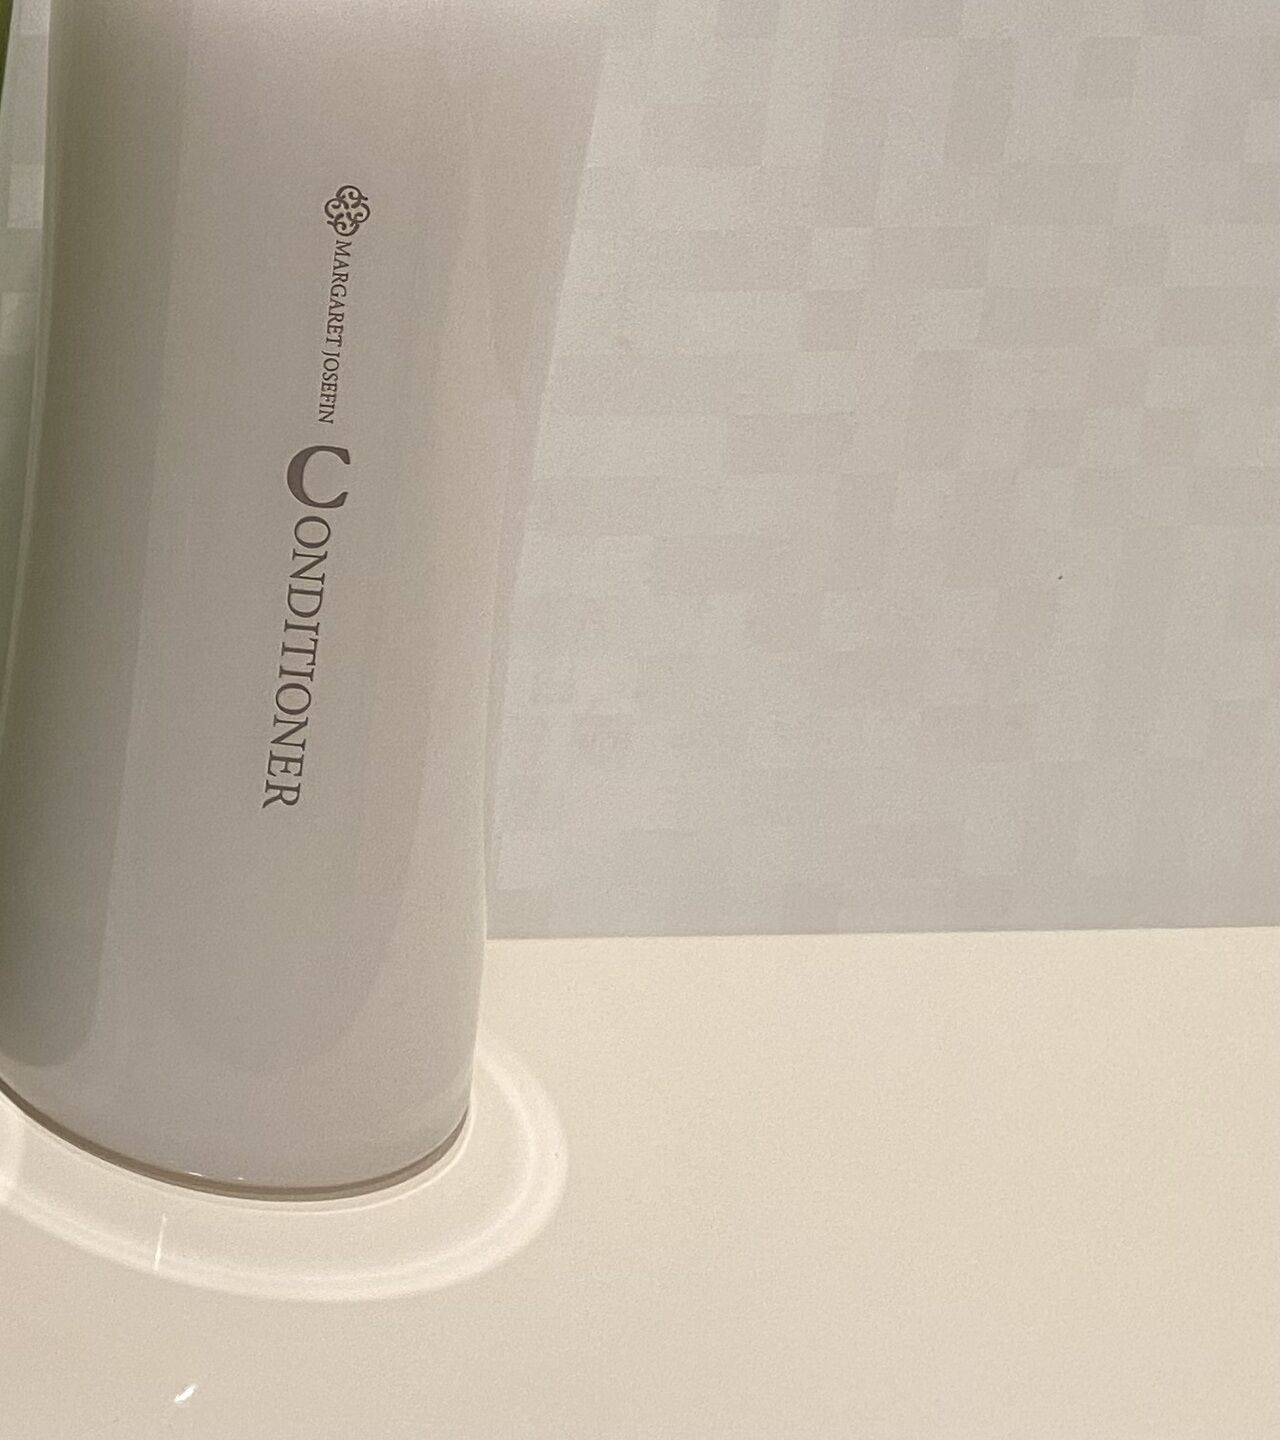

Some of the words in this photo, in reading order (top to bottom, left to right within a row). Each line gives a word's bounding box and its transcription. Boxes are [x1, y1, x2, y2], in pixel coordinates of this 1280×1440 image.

[326, 240, 351, 346] MARGARET
[318, 350, 340, 424] JOSEFIN
[262, 445, 351, 809] CONDITIONER
